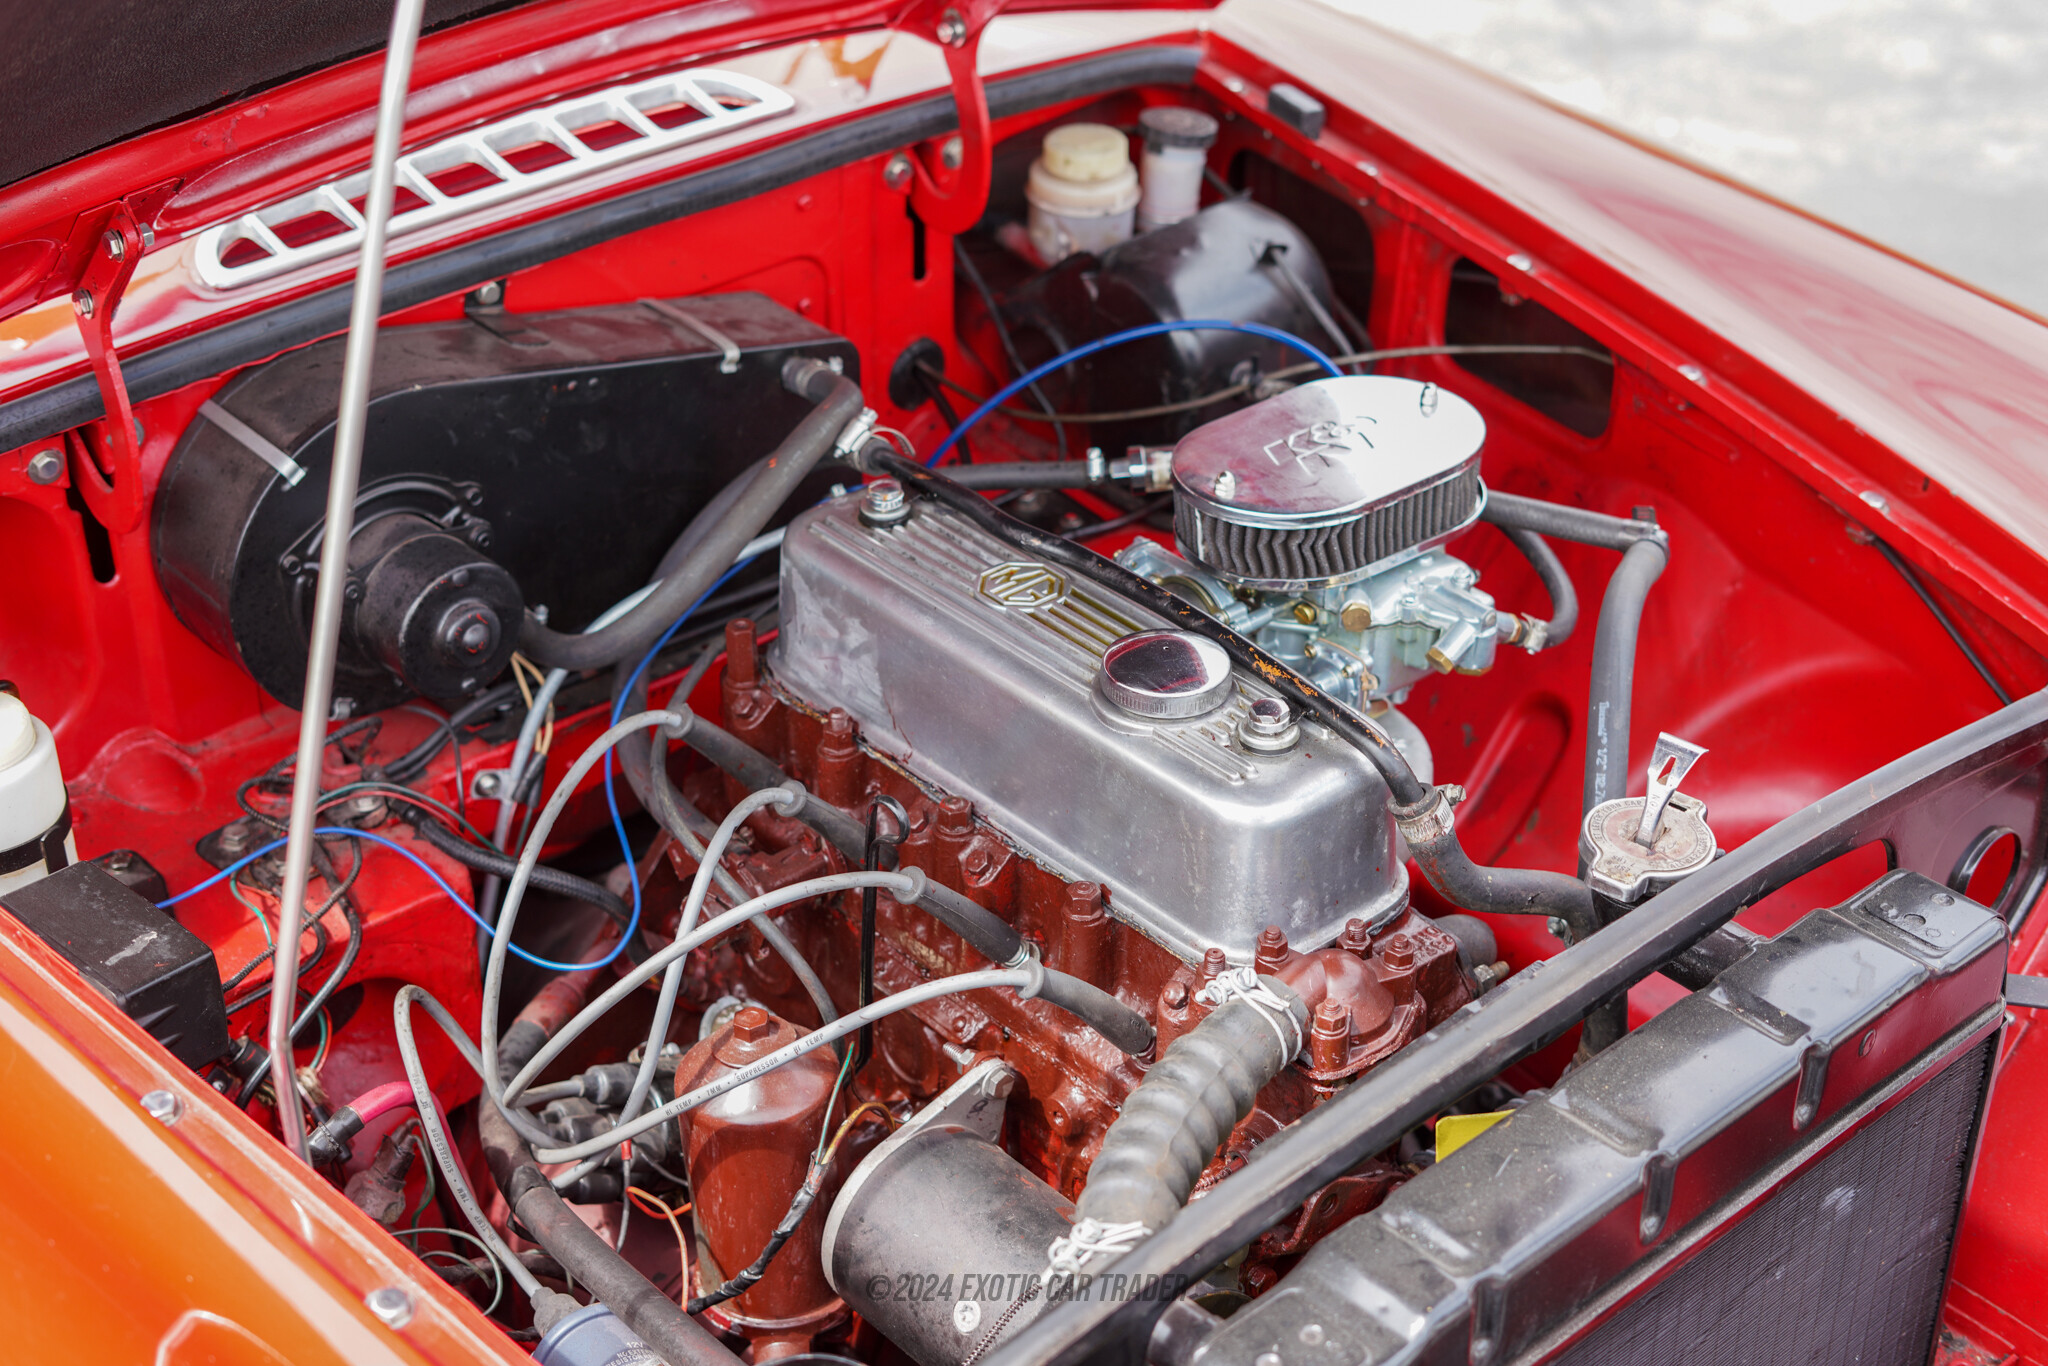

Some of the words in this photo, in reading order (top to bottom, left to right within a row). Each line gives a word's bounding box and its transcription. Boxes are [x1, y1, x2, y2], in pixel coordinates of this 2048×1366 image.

[986, 566, 1060, 603] MG
[675, 1098, 693, 1112] TEMP
[706, 1084, 723, 1097] 7MM
[735, 1056, 780, 1082] SUPPRESSOR
[805, 1032, 825, 1048] TEMP
[431, 1127, 454, 1174] SUPPRESSOR
[456, 1187, 470, 1204] 7MM
